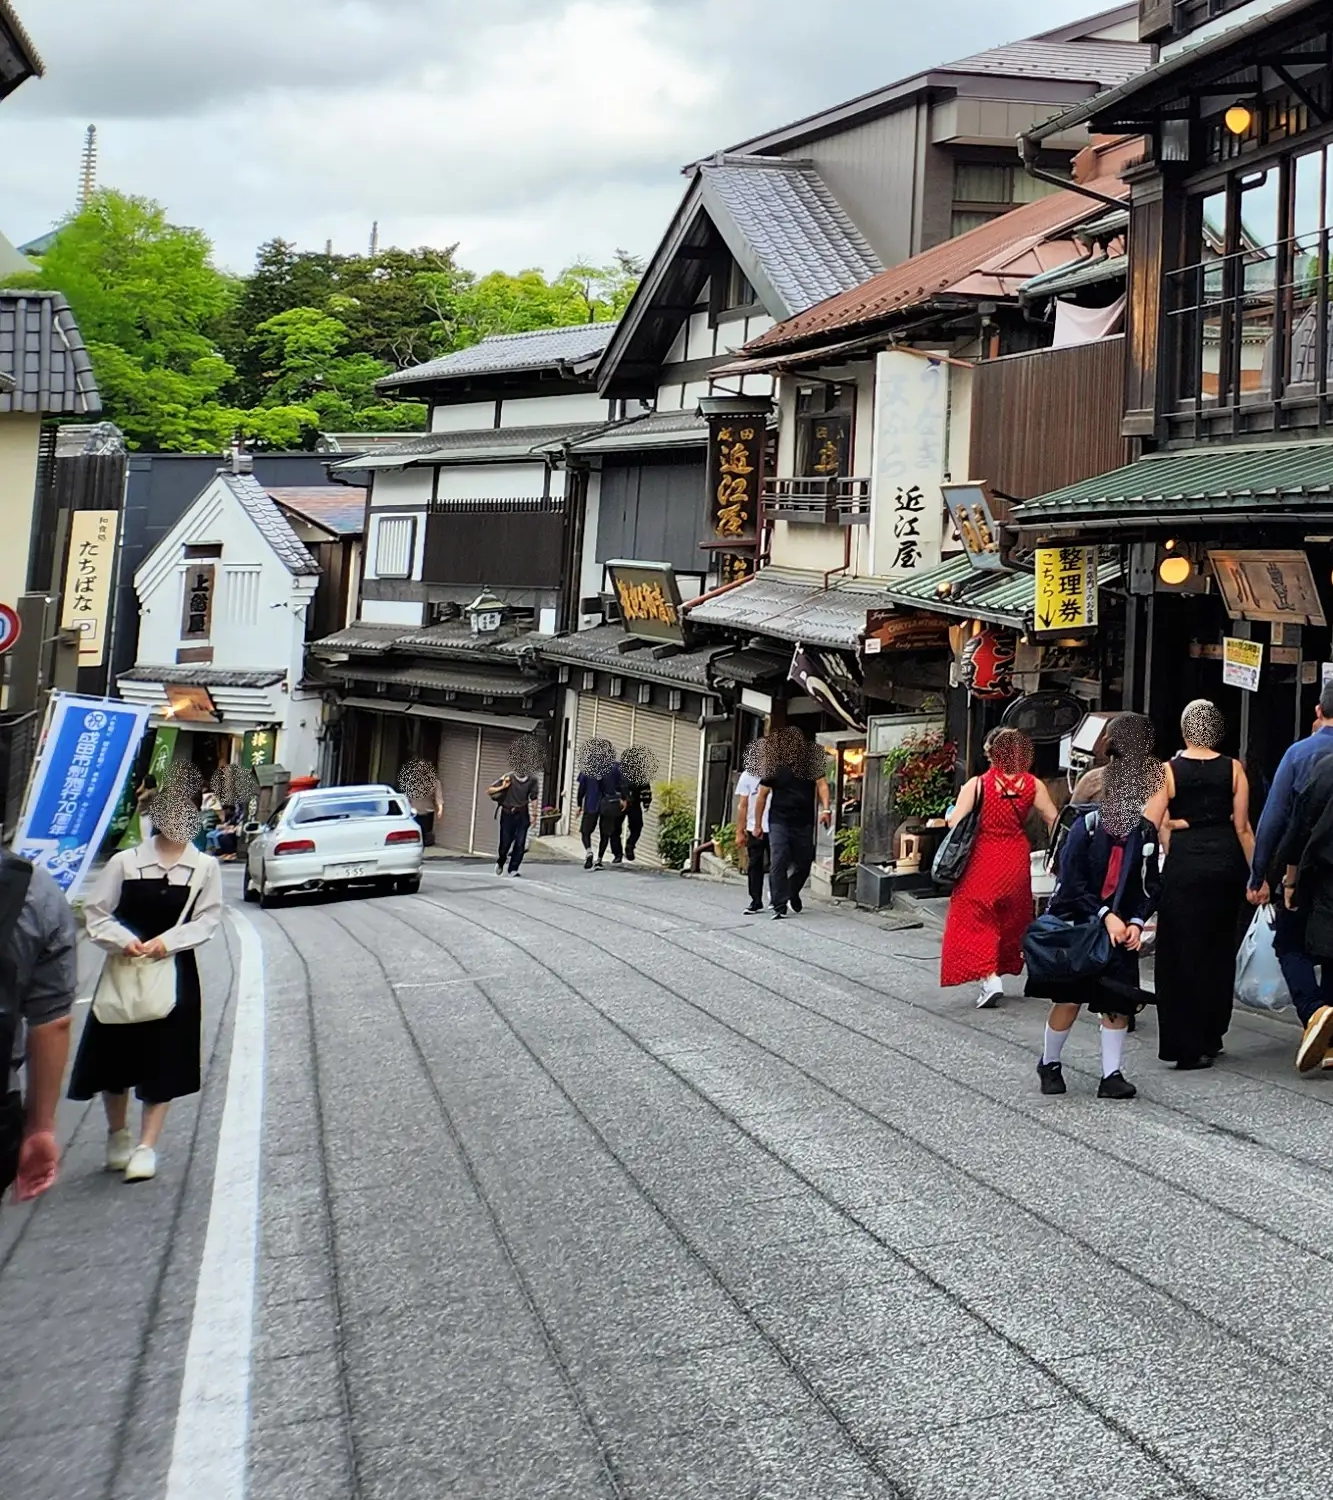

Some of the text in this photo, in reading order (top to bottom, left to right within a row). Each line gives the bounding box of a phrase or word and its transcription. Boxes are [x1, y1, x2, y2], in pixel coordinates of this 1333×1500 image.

[715, 443, 754, 538] 近江屋
[891, 485, 926, 569] 近江屋
[73, 541, 98, 611] たちばな
[1042, 554, 1055, 597] こちら
[1058, 547, 1082, 622] 整理券
